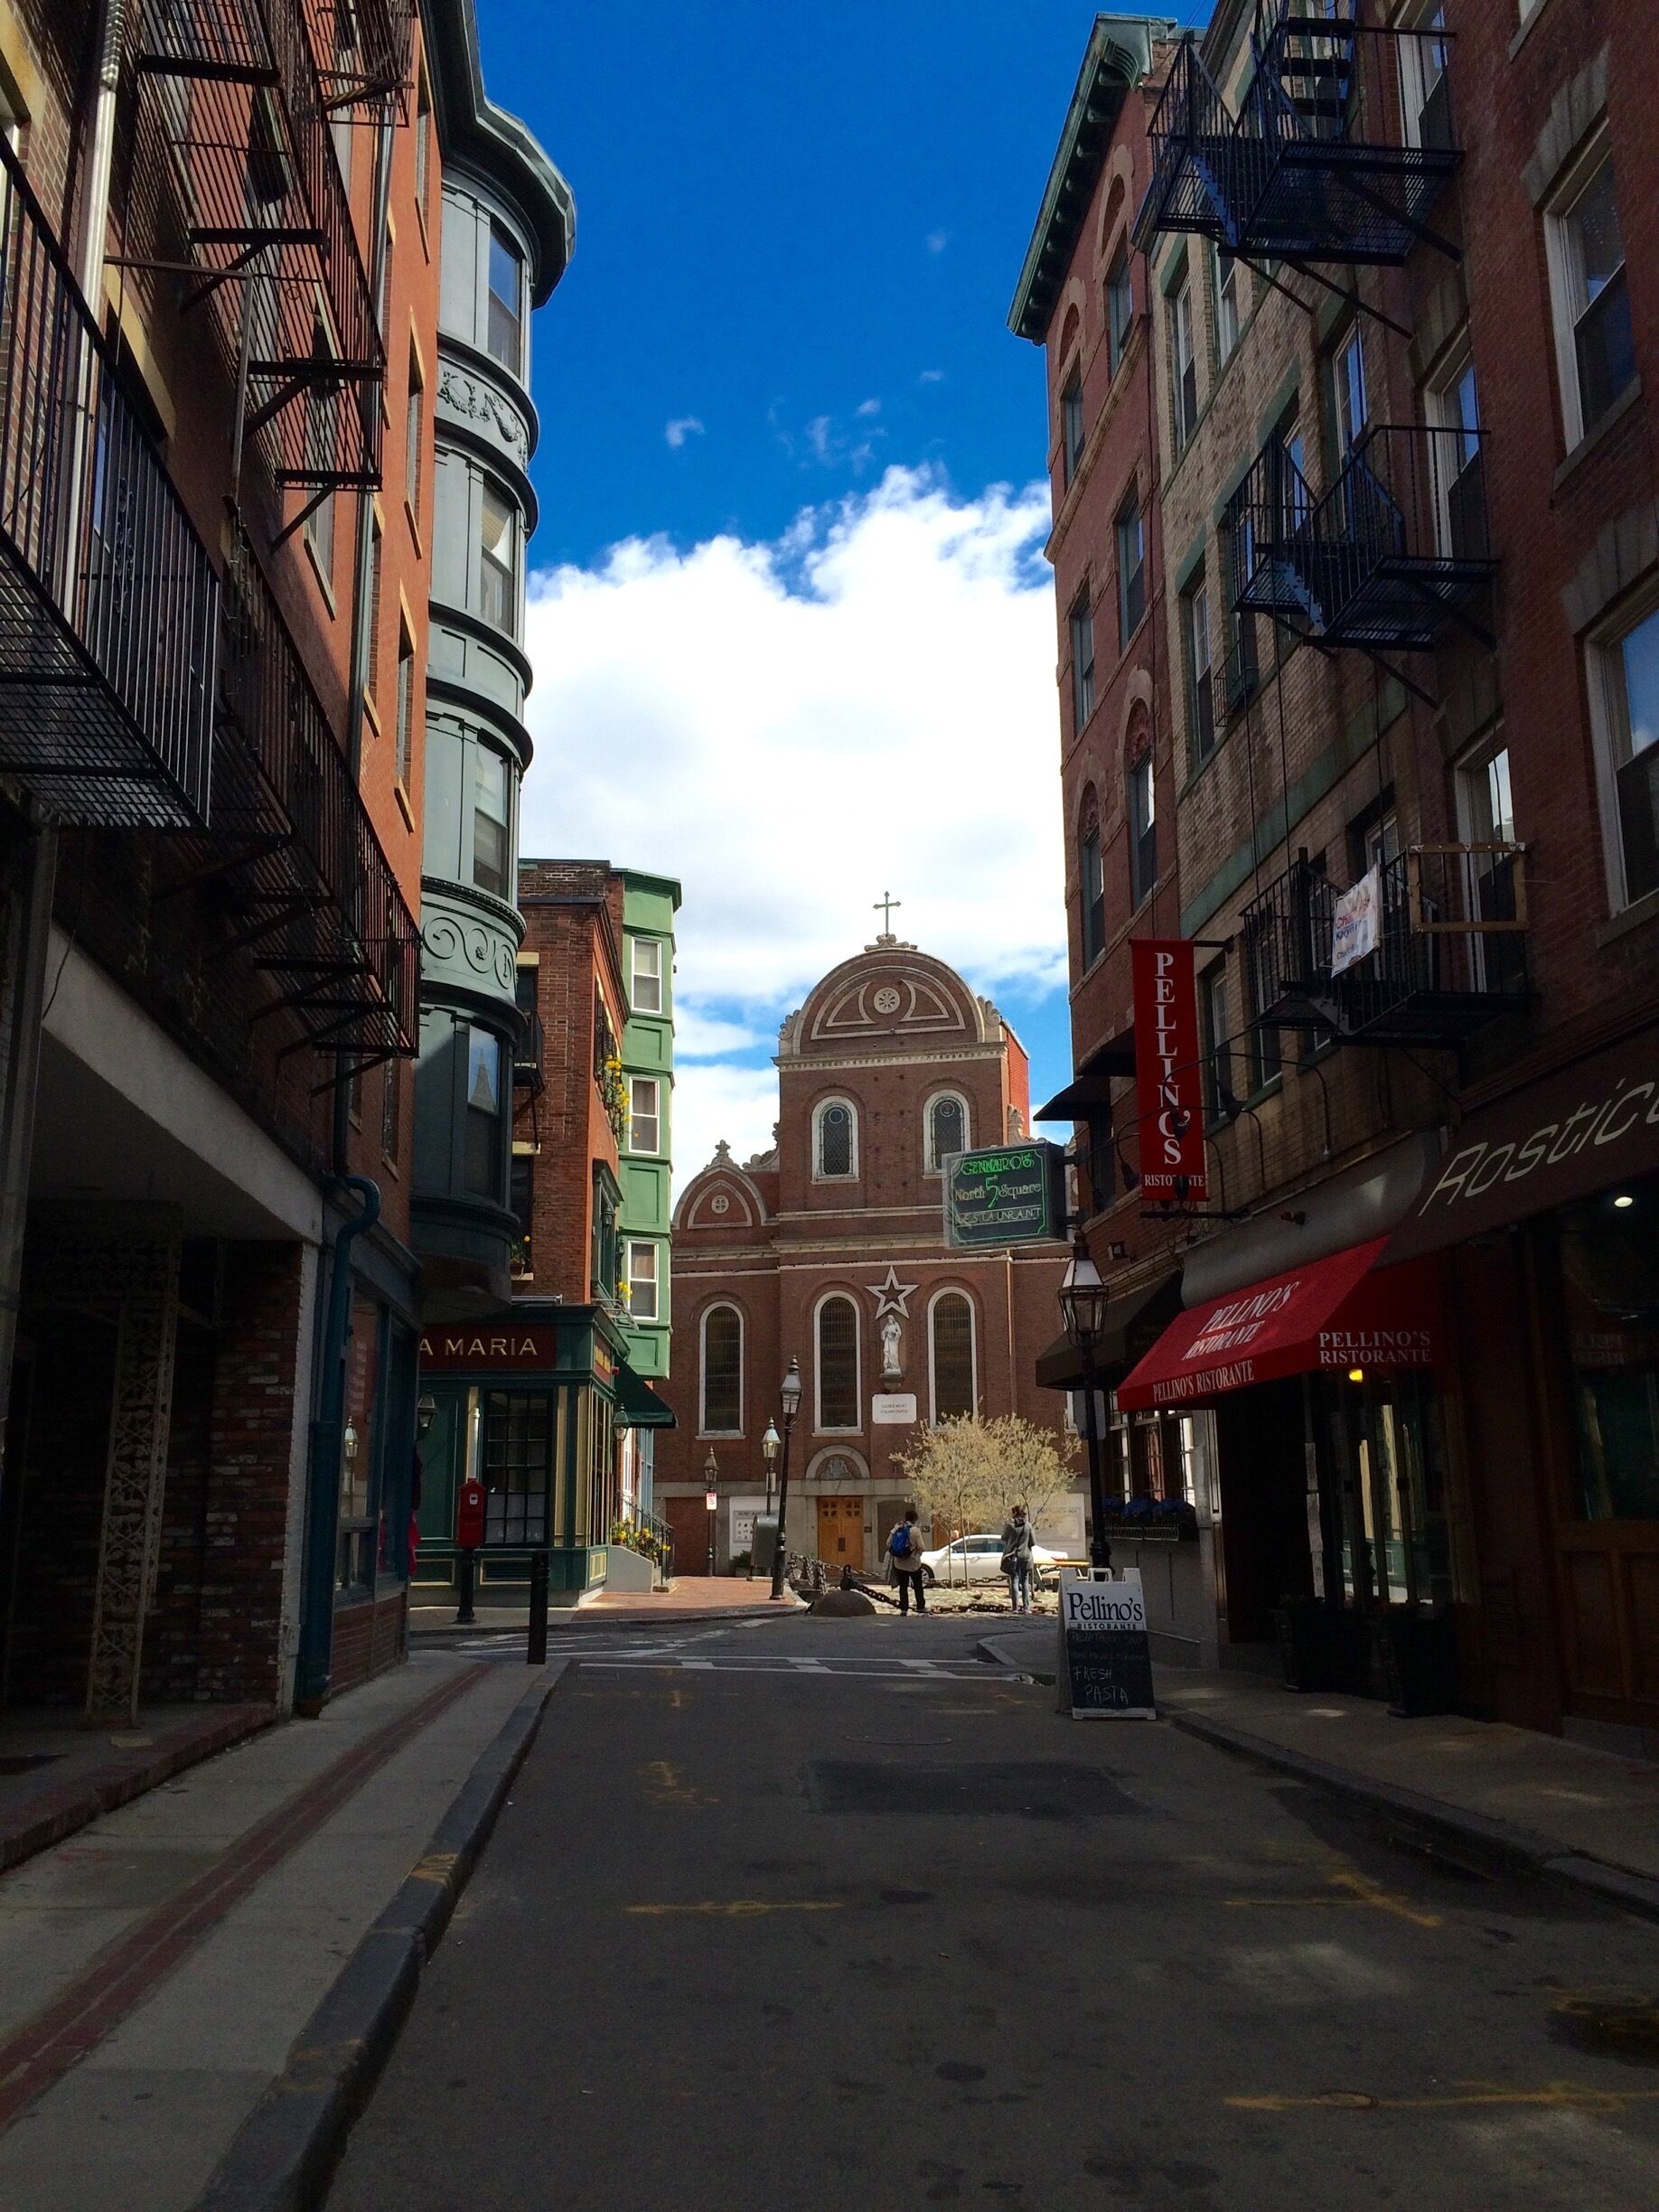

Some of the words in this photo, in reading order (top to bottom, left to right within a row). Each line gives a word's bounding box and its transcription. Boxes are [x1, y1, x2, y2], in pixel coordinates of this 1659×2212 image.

[954, 1185, 985, 1202] North
[985, 1176, 998, 1209] 5
[998, 1183, 1042, 1200] Square
[955, 1207, 1042, 1225] RESTAURANT
[1197, 1280, 1300, 1336] PELLINO'S
[445, 1338, 538, 1355] MARIA
[1181, 1319, 1266, 1361] RISTORANTE
[1319, 1330, 1431, 1347] PELLINO'S
[1320, 1349, 1432, 1364] RISTORANTE
[1153, 1374, 1194, 1402] PELLINO'S
[1195, 1359, 1255, 1393] RISTORANTE
[1067, 1592, 1143, 1621] Pellino's
[1077, 1623, 1137, 1631] RISTORANTE
[1073, 1665, 1112, 1682] FRESH
[1084, 1683, 1129, 1704] PASTA
